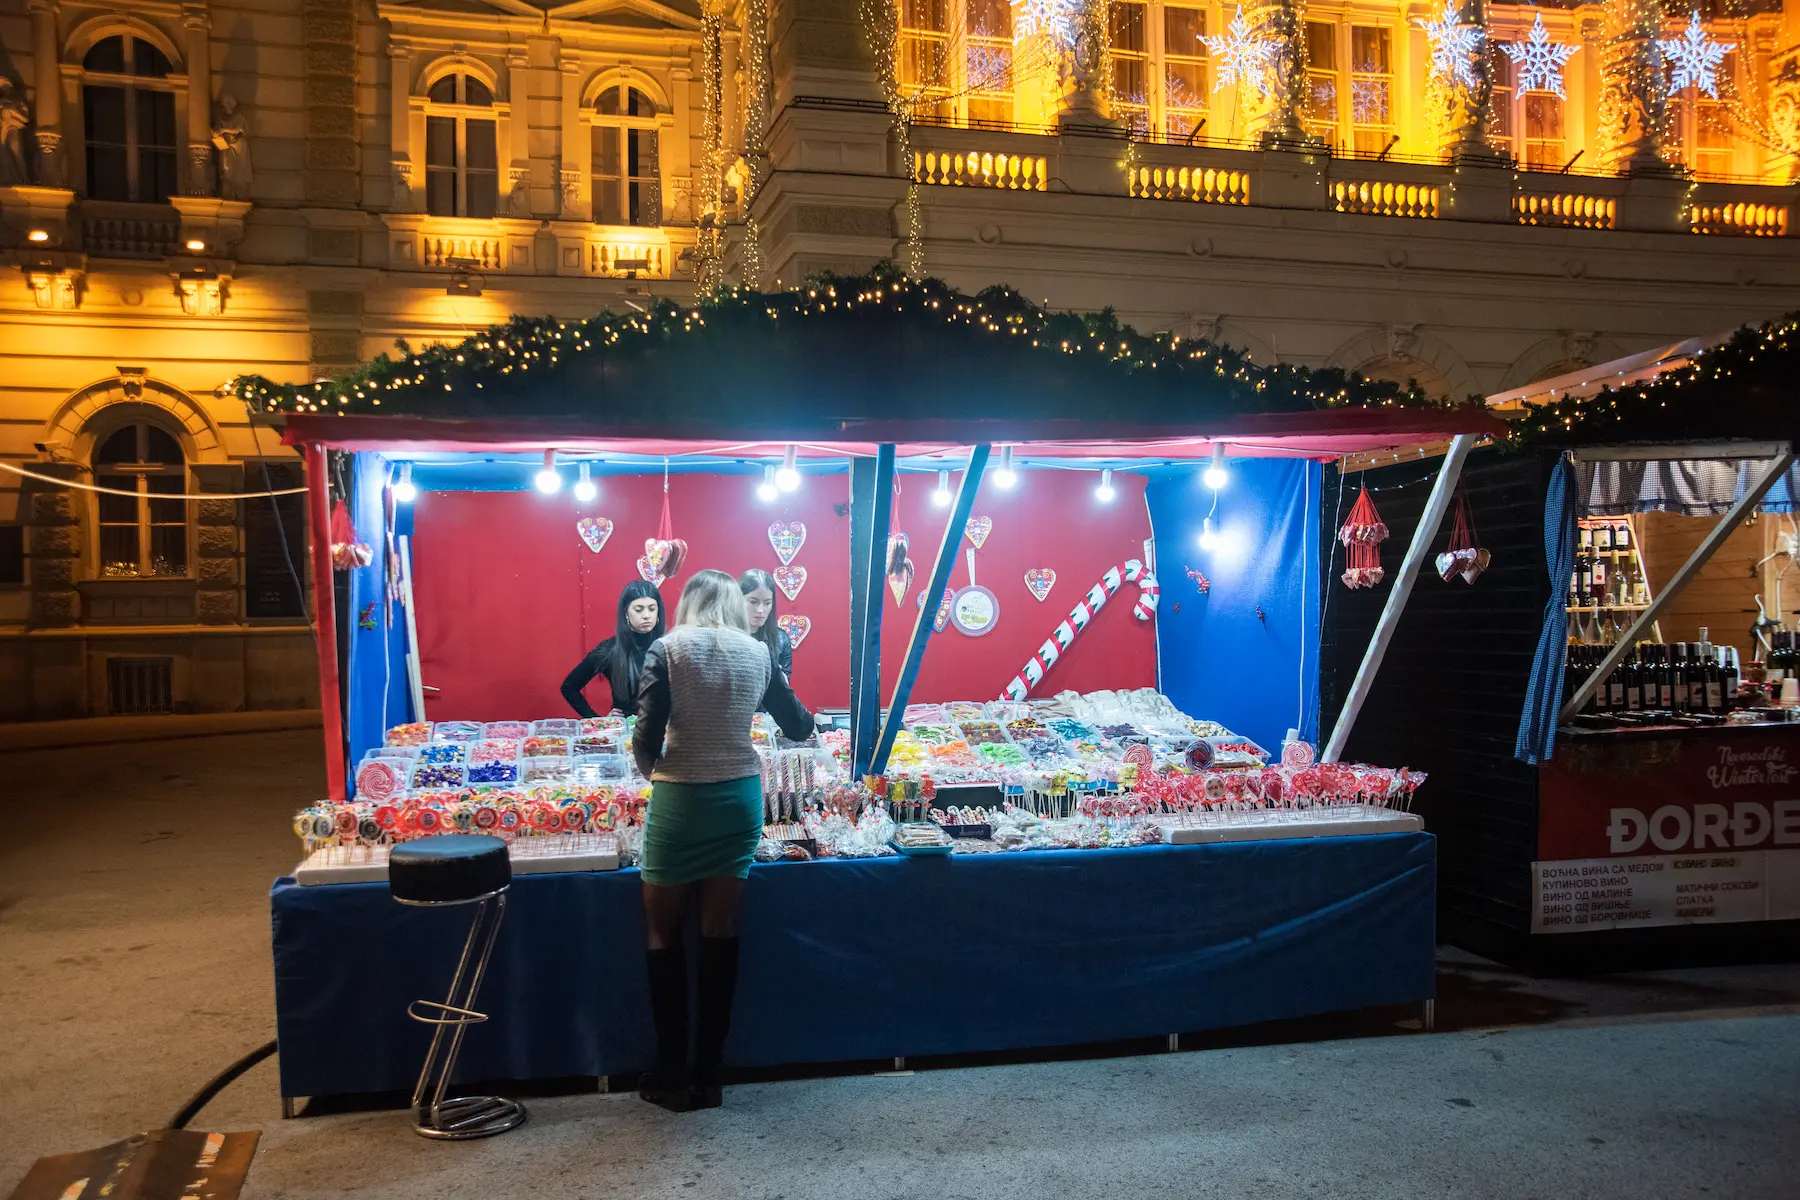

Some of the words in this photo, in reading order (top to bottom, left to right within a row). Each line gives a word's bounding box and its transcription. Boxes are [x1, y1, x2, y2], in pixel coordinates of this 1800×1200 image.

[1607, 800, 1800, 853] ĐORĐE
[1543, 868, 1579, 878] ВОЋНА
[1582, 866, 1609, 876] ВИНА
[1612, 865, 1625, 874] СА
[1628, 863, 1664, 875] МЕДОМ
[1543, 879, 1597, 889] КУПИНОВО
[1601, 877, 1628, 886] ВИНО
[1543, 892, 1571, 901] ВИНО
[1575, 891, 1589, 901] ОД
[1592, 888, 1633, 898] МАЛИНЕ
[1676, 896, 1714, 905] СЛАТКА
[1543, 904, 1572, 914] ВИНО
[1575, 903, 1588, 912] ОД
[1591, 900, 1631, 910] ВИШЊЕ
[1543, 916, 1571, 925] ВИНО
[1575, 915, 1588, 923] ОД
[1591, 910, 1652, 922] БОРОВНИЦЕ
